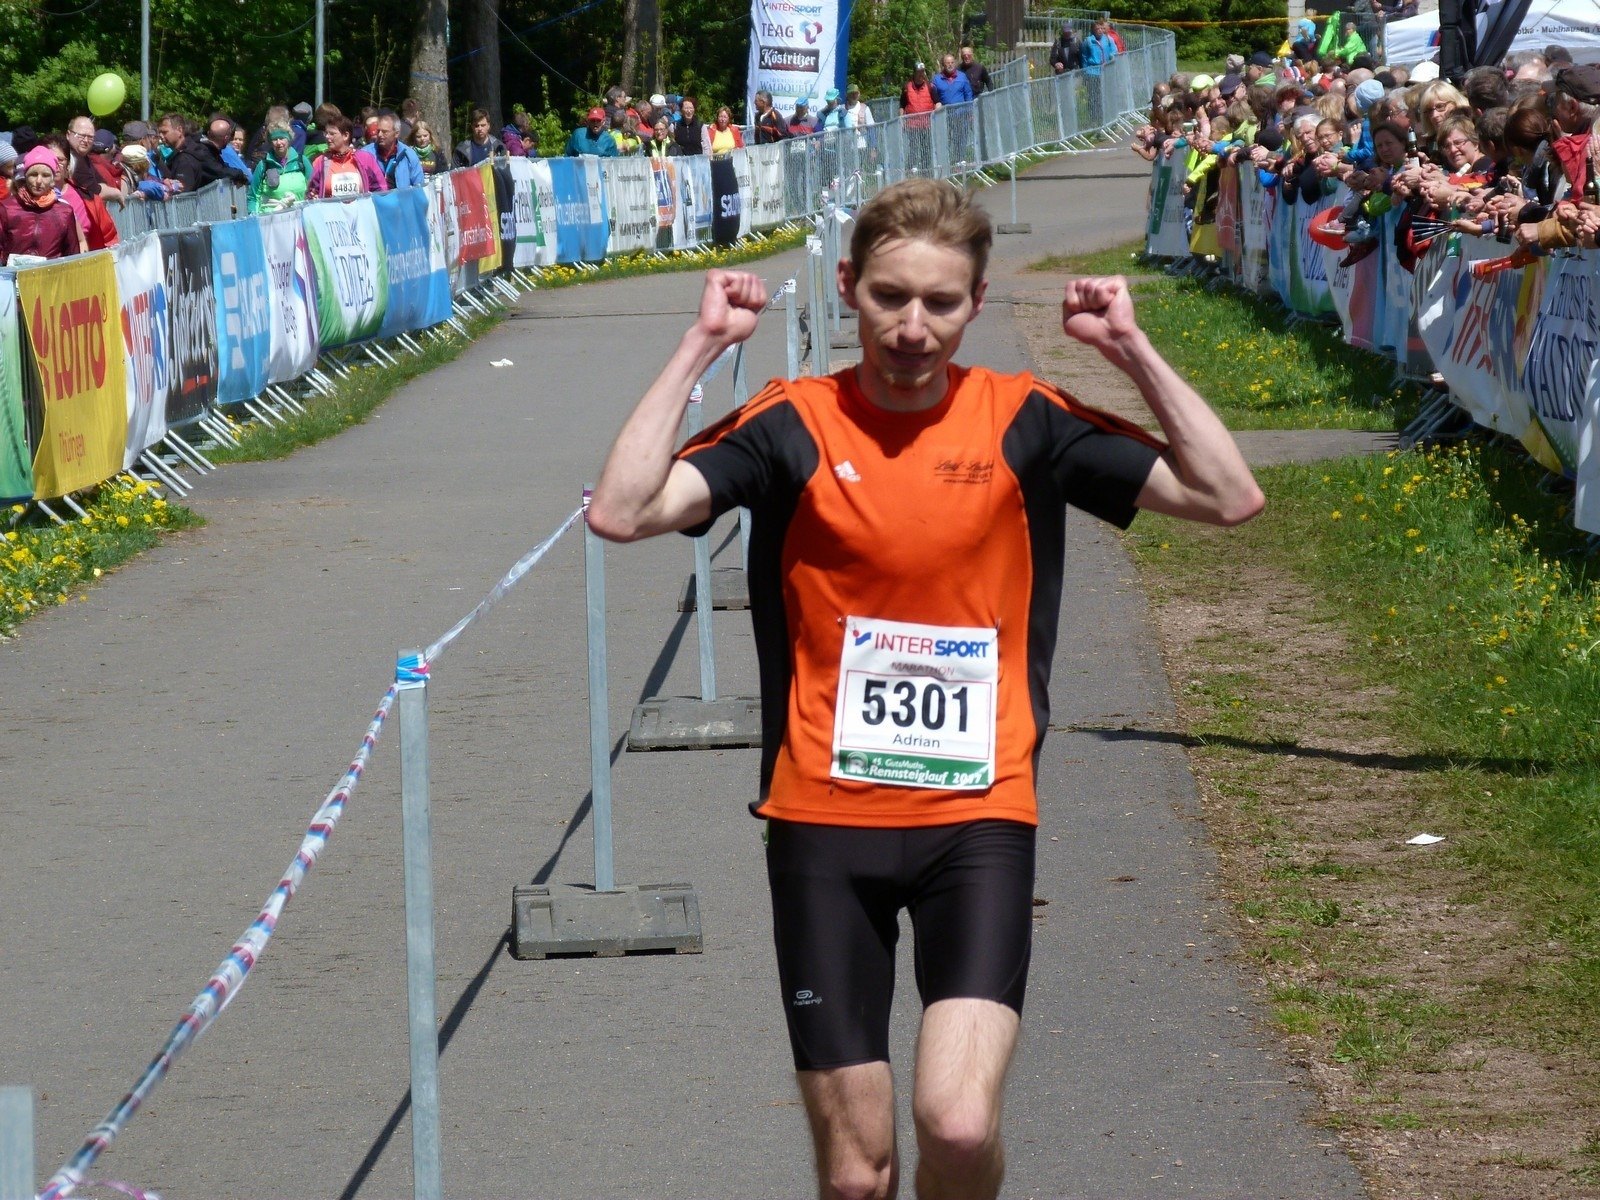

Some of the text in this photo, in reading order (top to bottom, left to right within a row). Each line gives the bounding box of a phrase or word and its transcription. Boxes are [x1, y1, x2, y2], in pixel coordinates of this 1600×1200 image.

[769, 2, 823, 13] INTERSPORT
[762, 23, 794, 38] TEAG
[761, 48, 816, 67] Köstritzer
[50, 295, 106, 401] LOTTO
[874, 632, 989, 658] INTERSPORT
[891, 662, 955, 675] MARATHON
[862, 679, 968, 732] 5301
[893, 734, 941, 749] Adrian
[869, 765, 983, 786] Rennsteiglauf 2017
